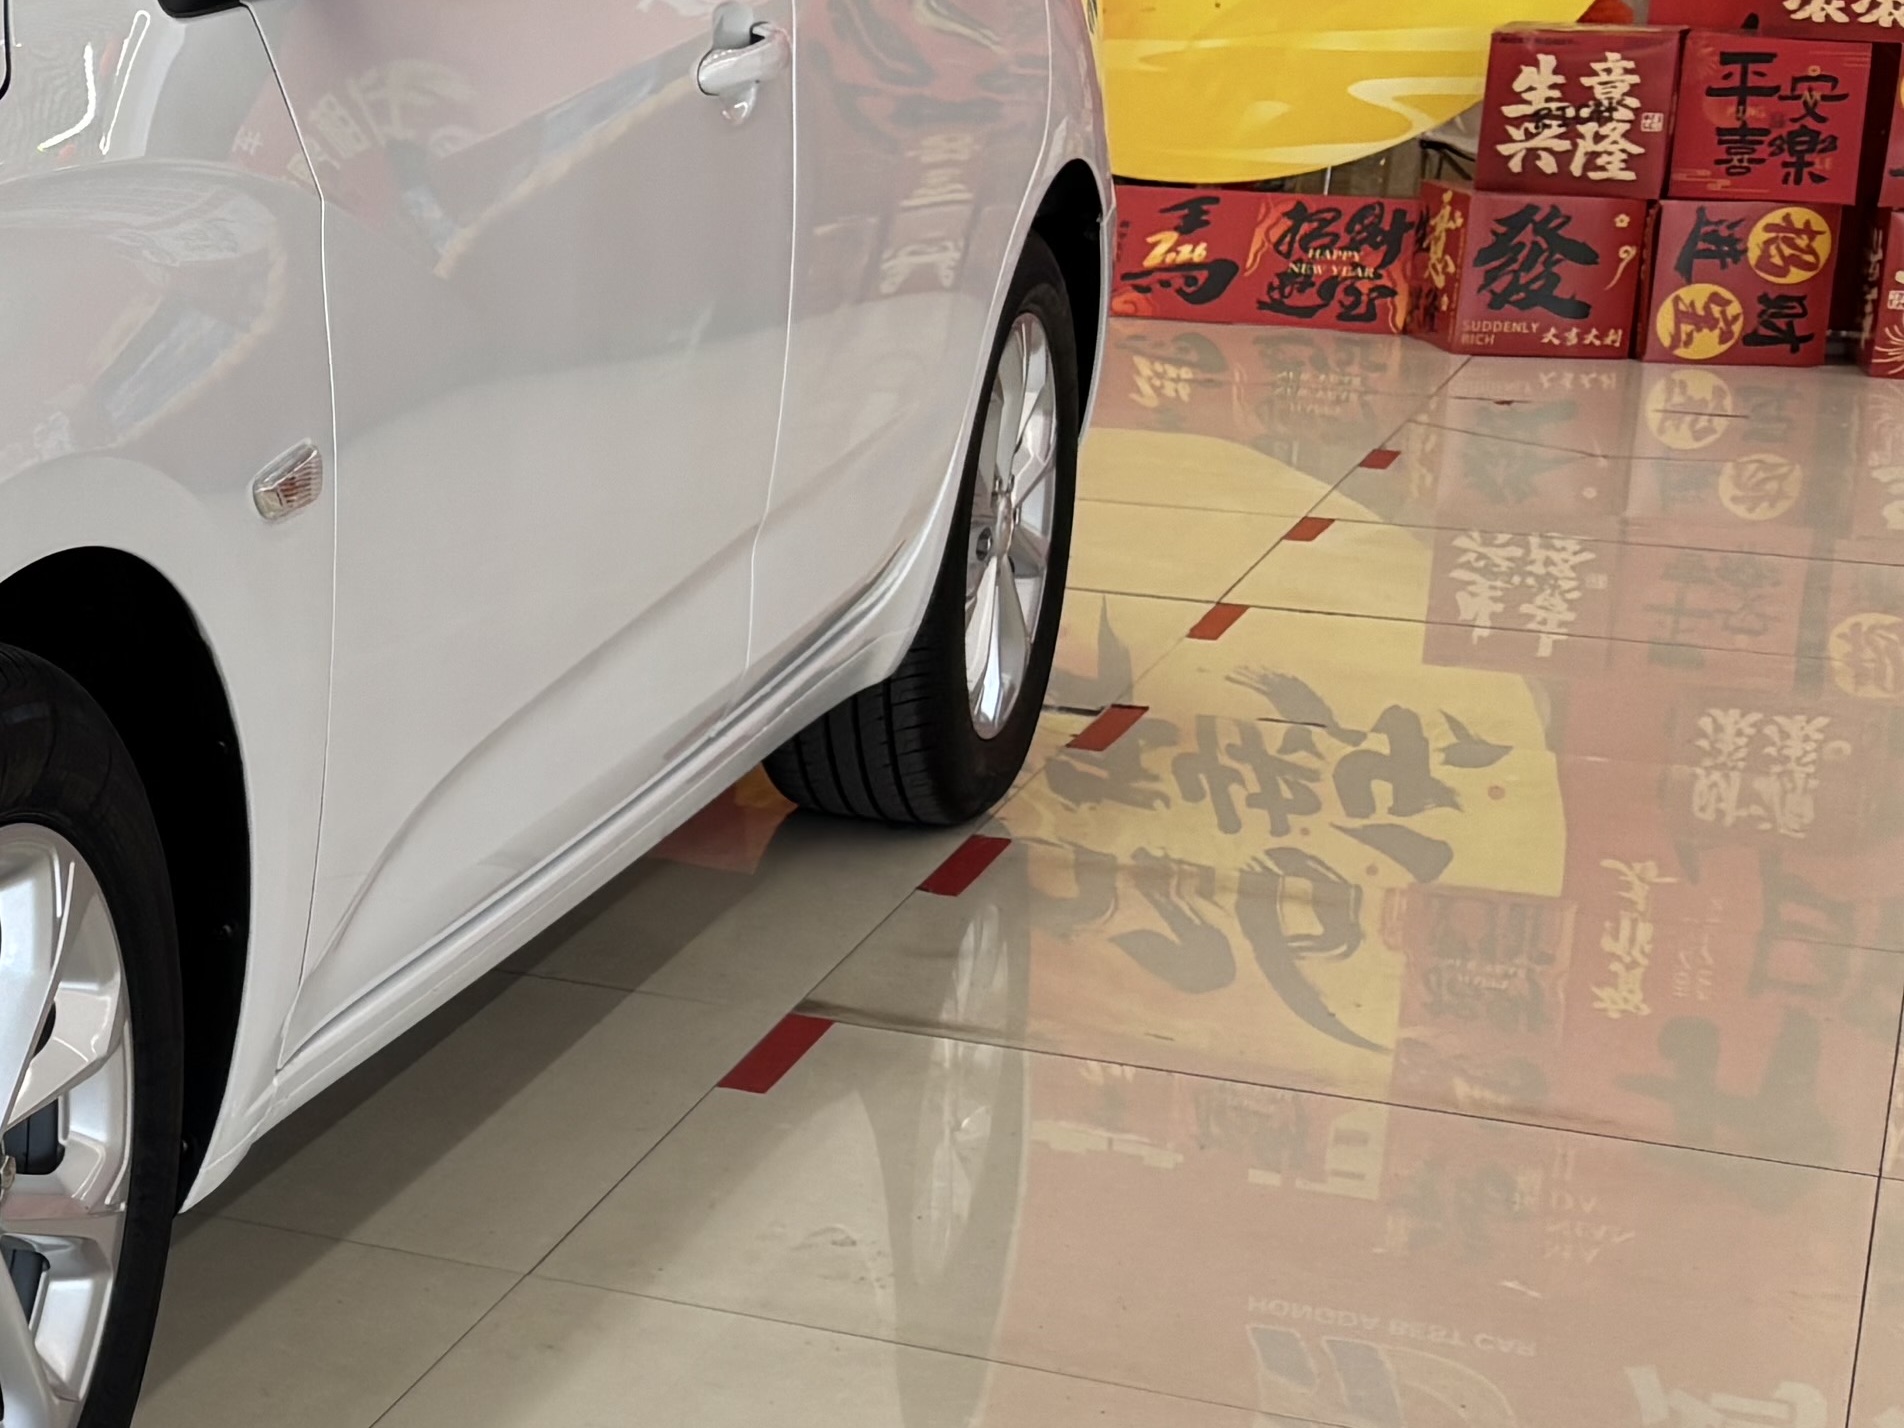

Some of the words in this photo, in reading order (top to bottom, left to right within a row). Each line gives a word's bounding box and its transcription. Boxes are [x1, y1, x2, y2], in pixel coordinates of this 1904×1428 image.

[1307, 248, 1364, 262] HAPPY
[1288, 262, 1331, 276] NEW
[1333, 264, 1376, 279] YEAR
[1461, 321, 1540, 334] SUDDENLY
[1460, 334, 1495, 346] RICH
[1542, 326, 1623, 348] 大吉大利
